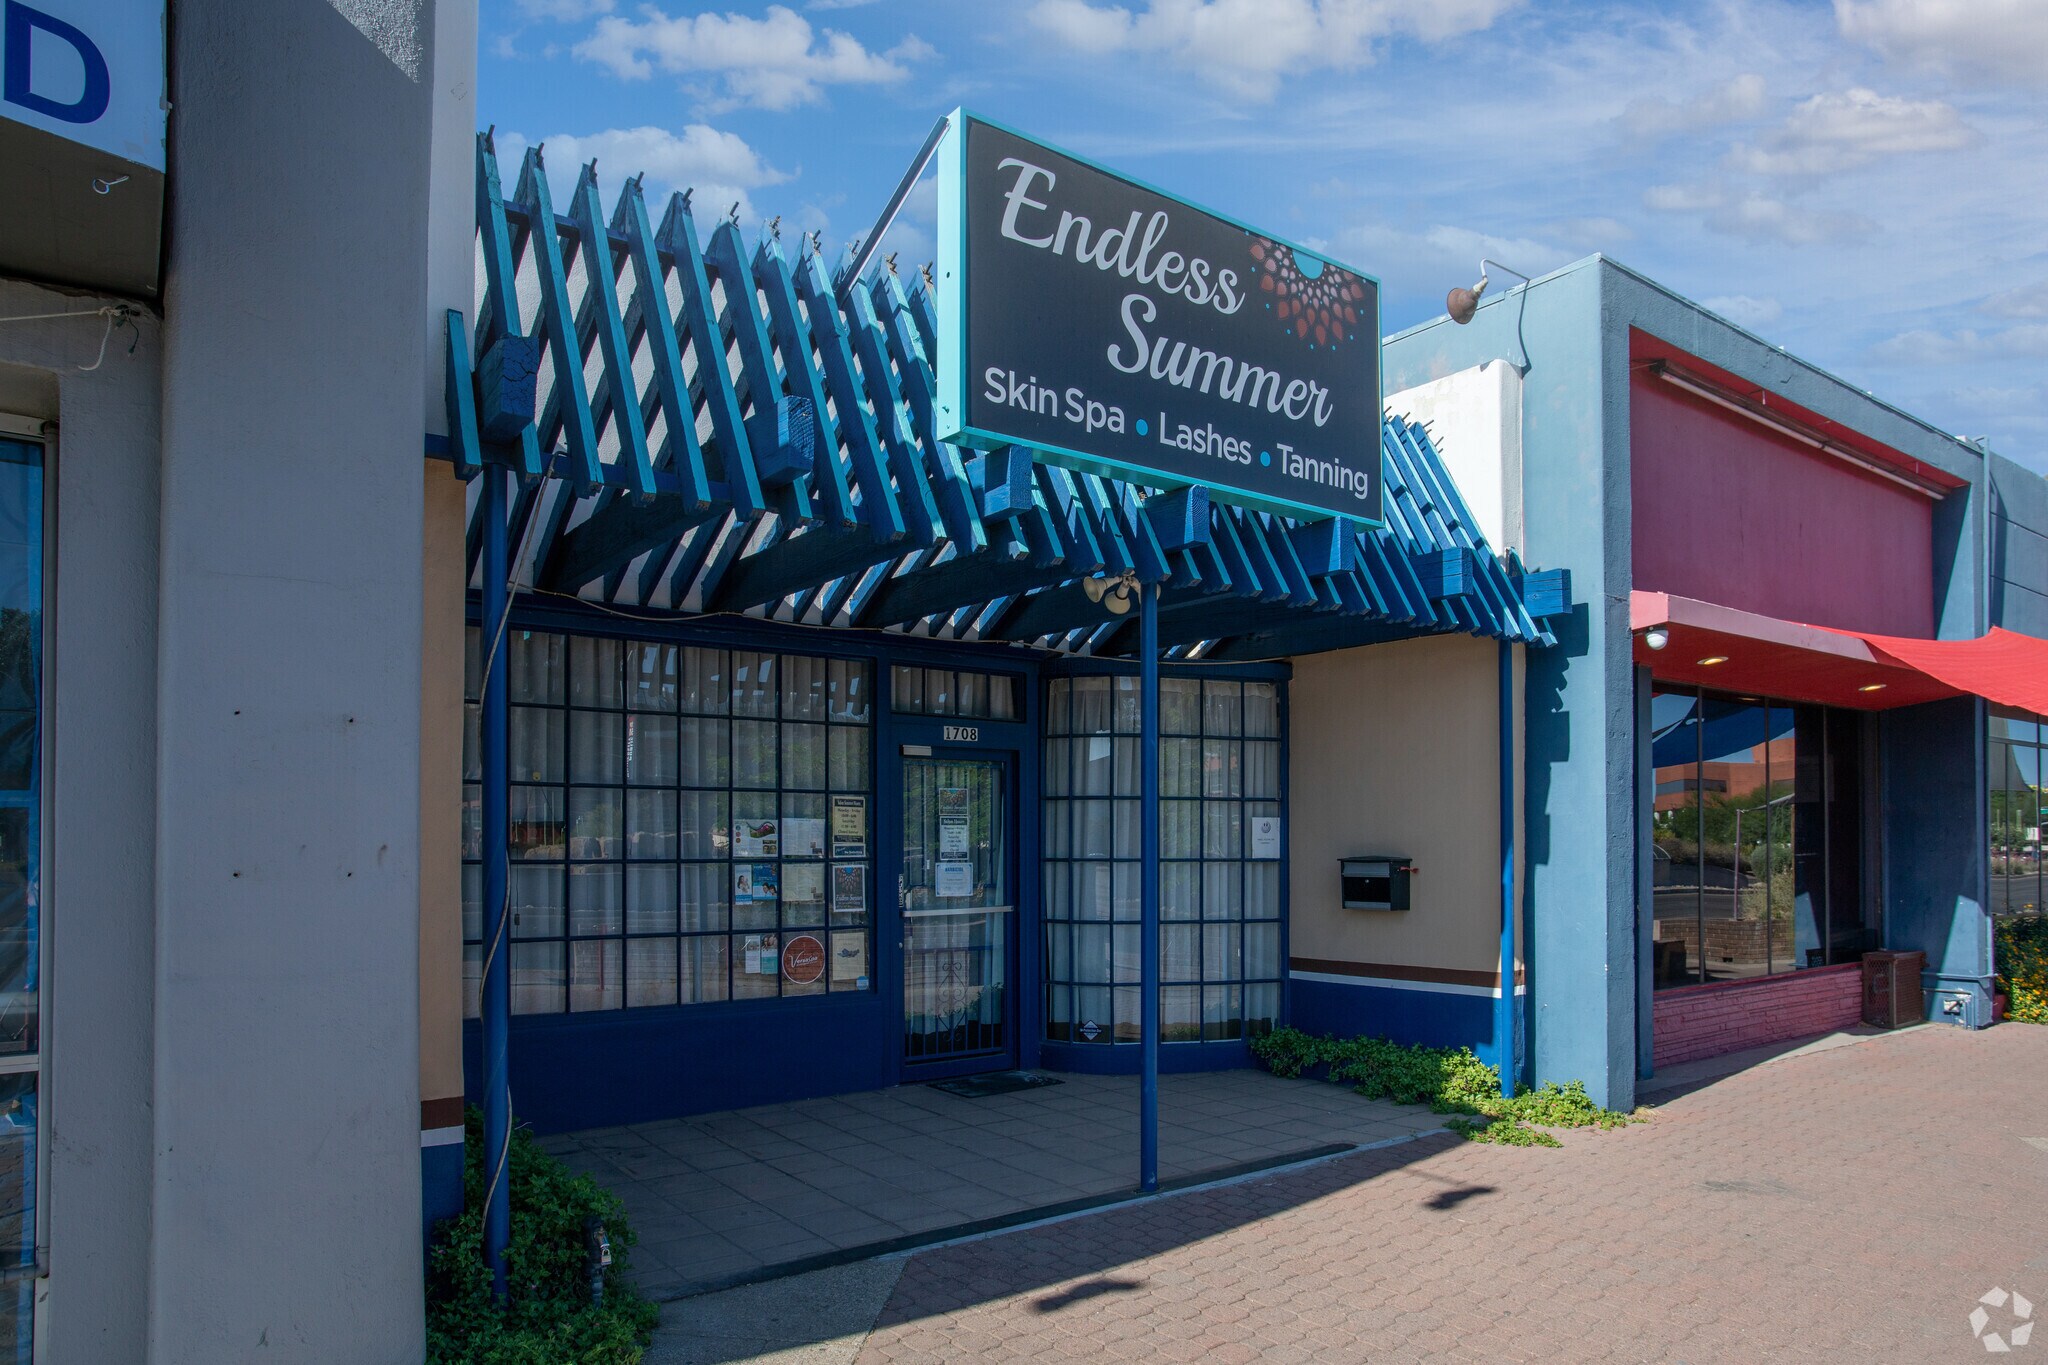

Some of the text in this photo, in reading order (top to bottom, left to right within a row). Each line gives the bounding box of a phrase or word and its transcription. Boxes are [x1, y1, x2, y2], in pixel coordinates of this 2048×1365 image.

[4, 0, 111, 124] D
[997, 157, 1246, 314] Endless
[1107, 294, 1333, 427] Summer
[984, 366, 1369, 500] Skin Spa Lashes Tanning
[945, 727, 977, 741] 1708
